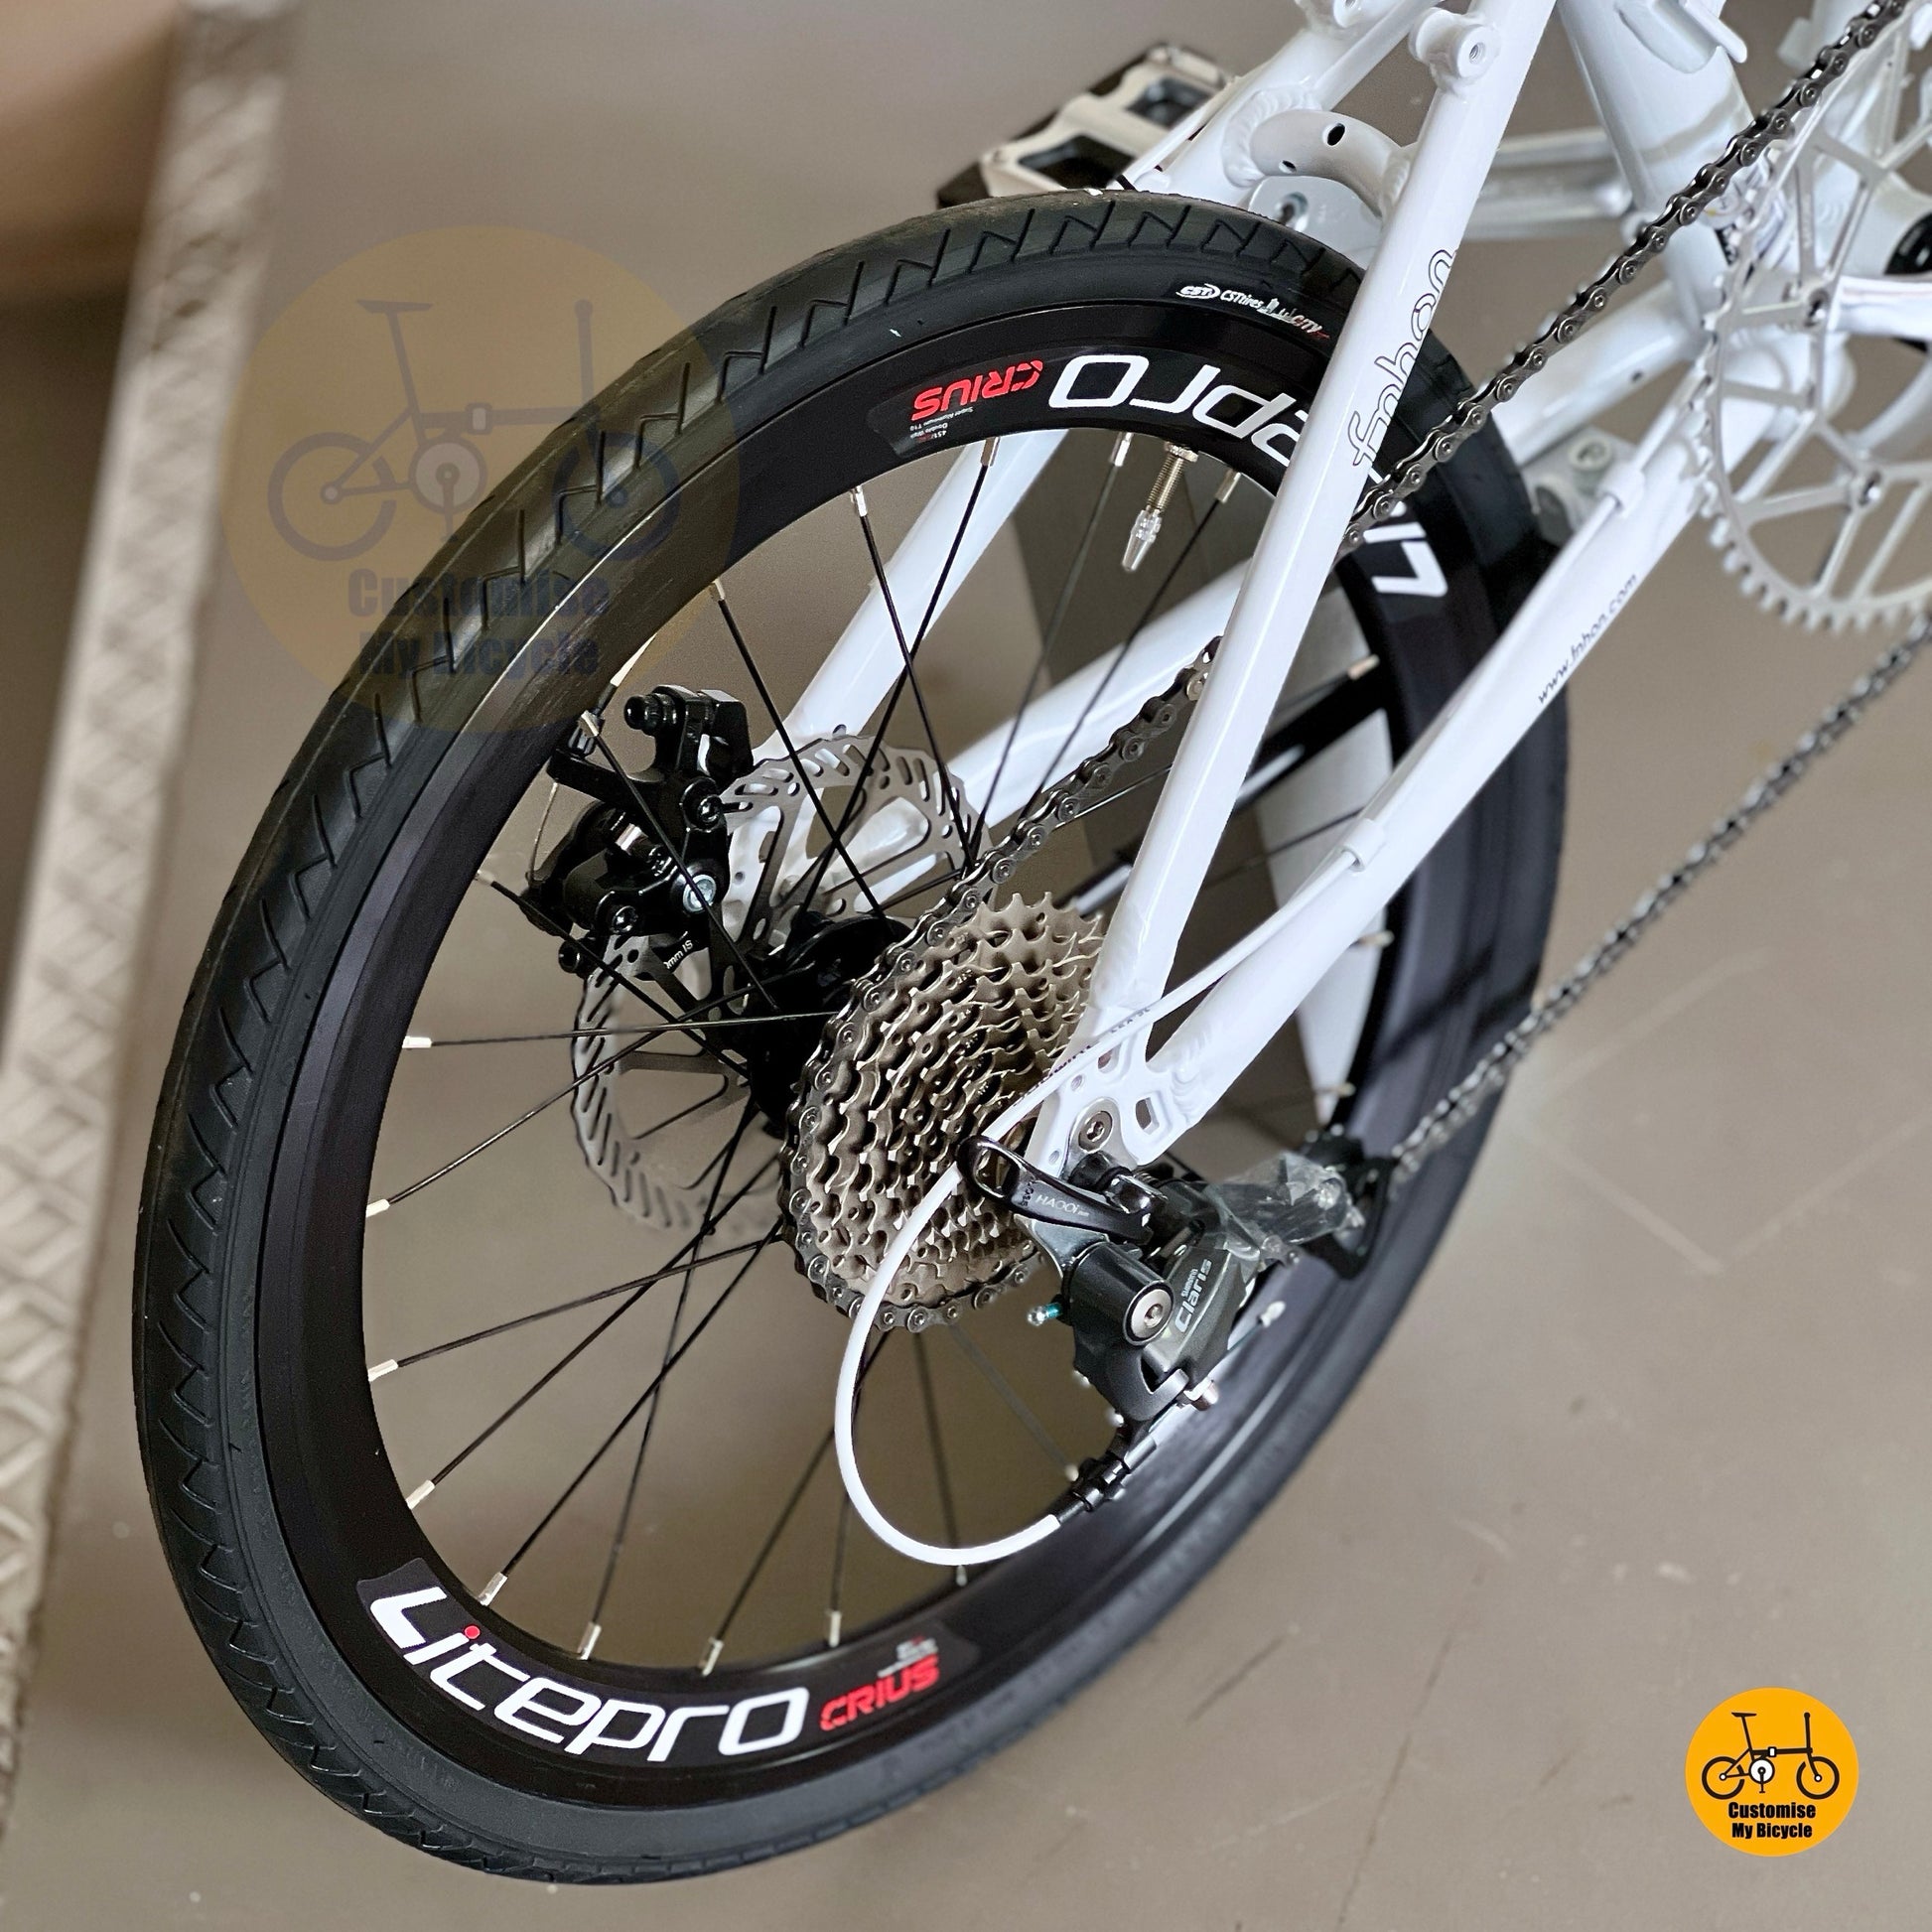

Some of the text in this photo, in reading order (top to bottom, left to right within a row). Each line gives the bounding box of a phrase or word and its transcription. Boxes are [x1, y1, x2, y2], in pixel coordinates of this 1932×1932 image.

[910, 359, 1043, 421] CRIUS
[1174, 1259, 1212, 1332] Claris
[820, 1652, 939, 1730] CRIUS
